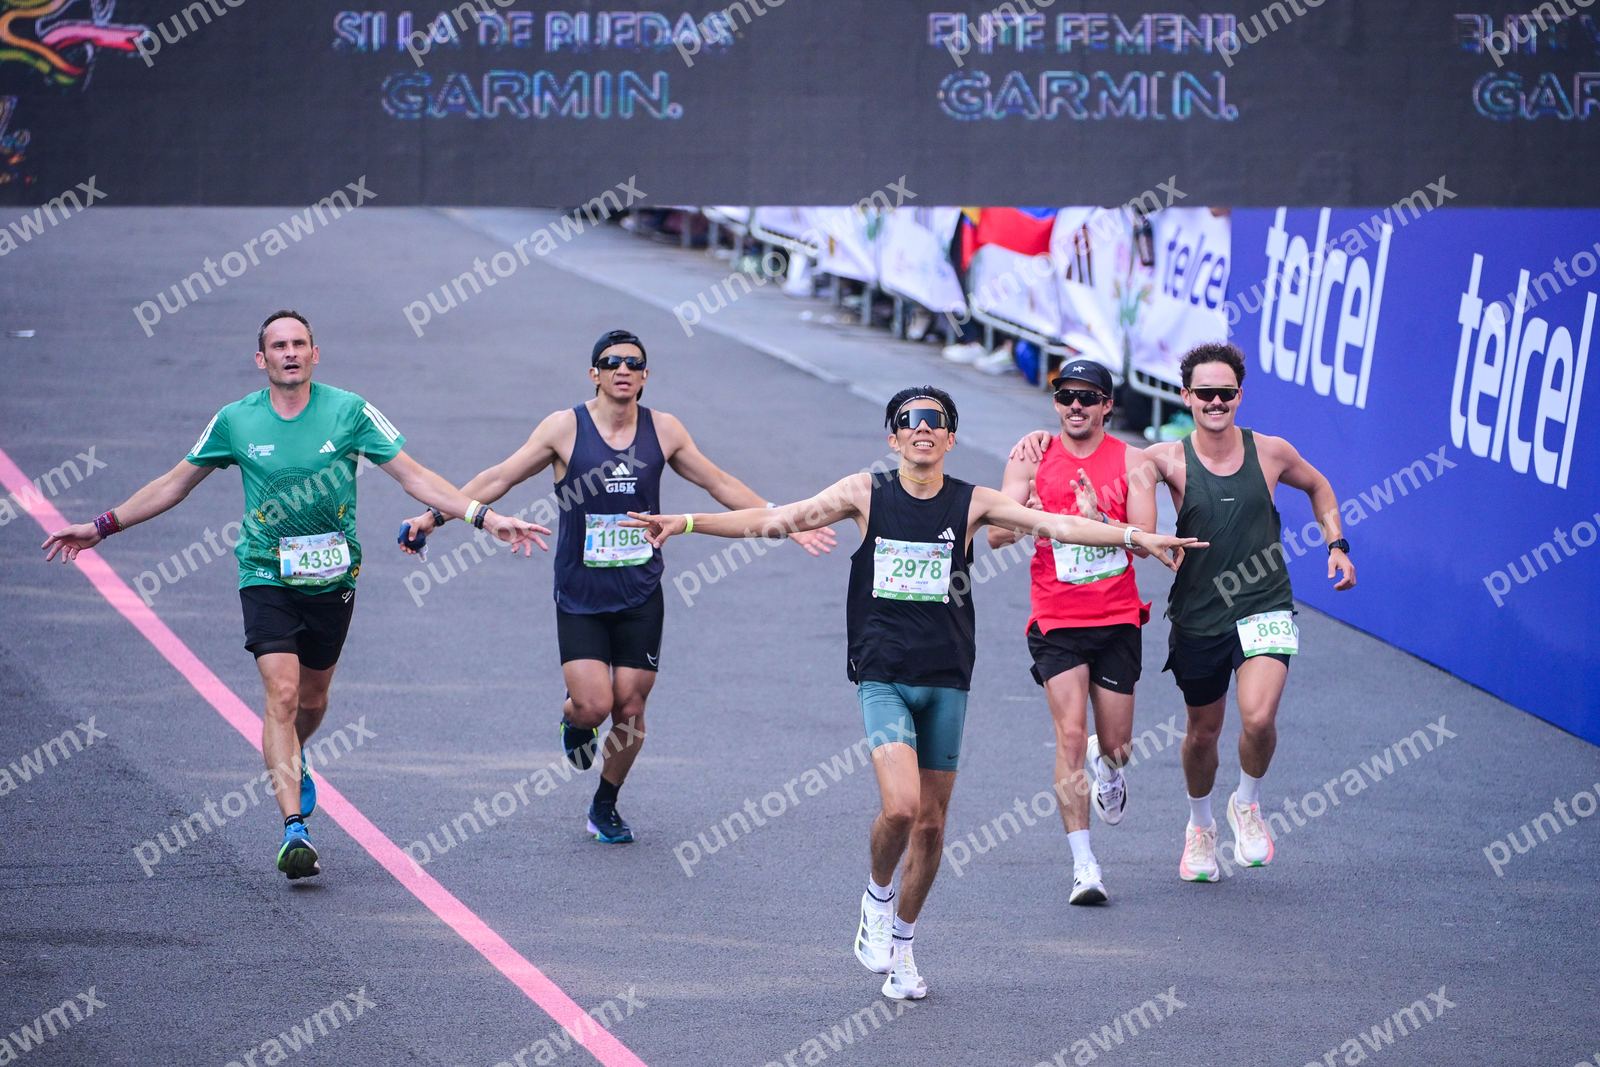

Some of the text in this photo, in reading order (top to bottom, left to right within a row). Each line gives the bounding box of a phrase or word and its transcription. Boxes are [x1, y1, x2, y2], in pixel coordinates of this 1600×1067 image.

[1163, 223, 1230, 312] telce
[1259, 206, 1393, 410] telcel
[1450, 252, 1598, 490] telcel
[605, 482, 636, 494] G15K
[298, 547, 343, 570] 4339
[891, 557, 942, 580] 2978
